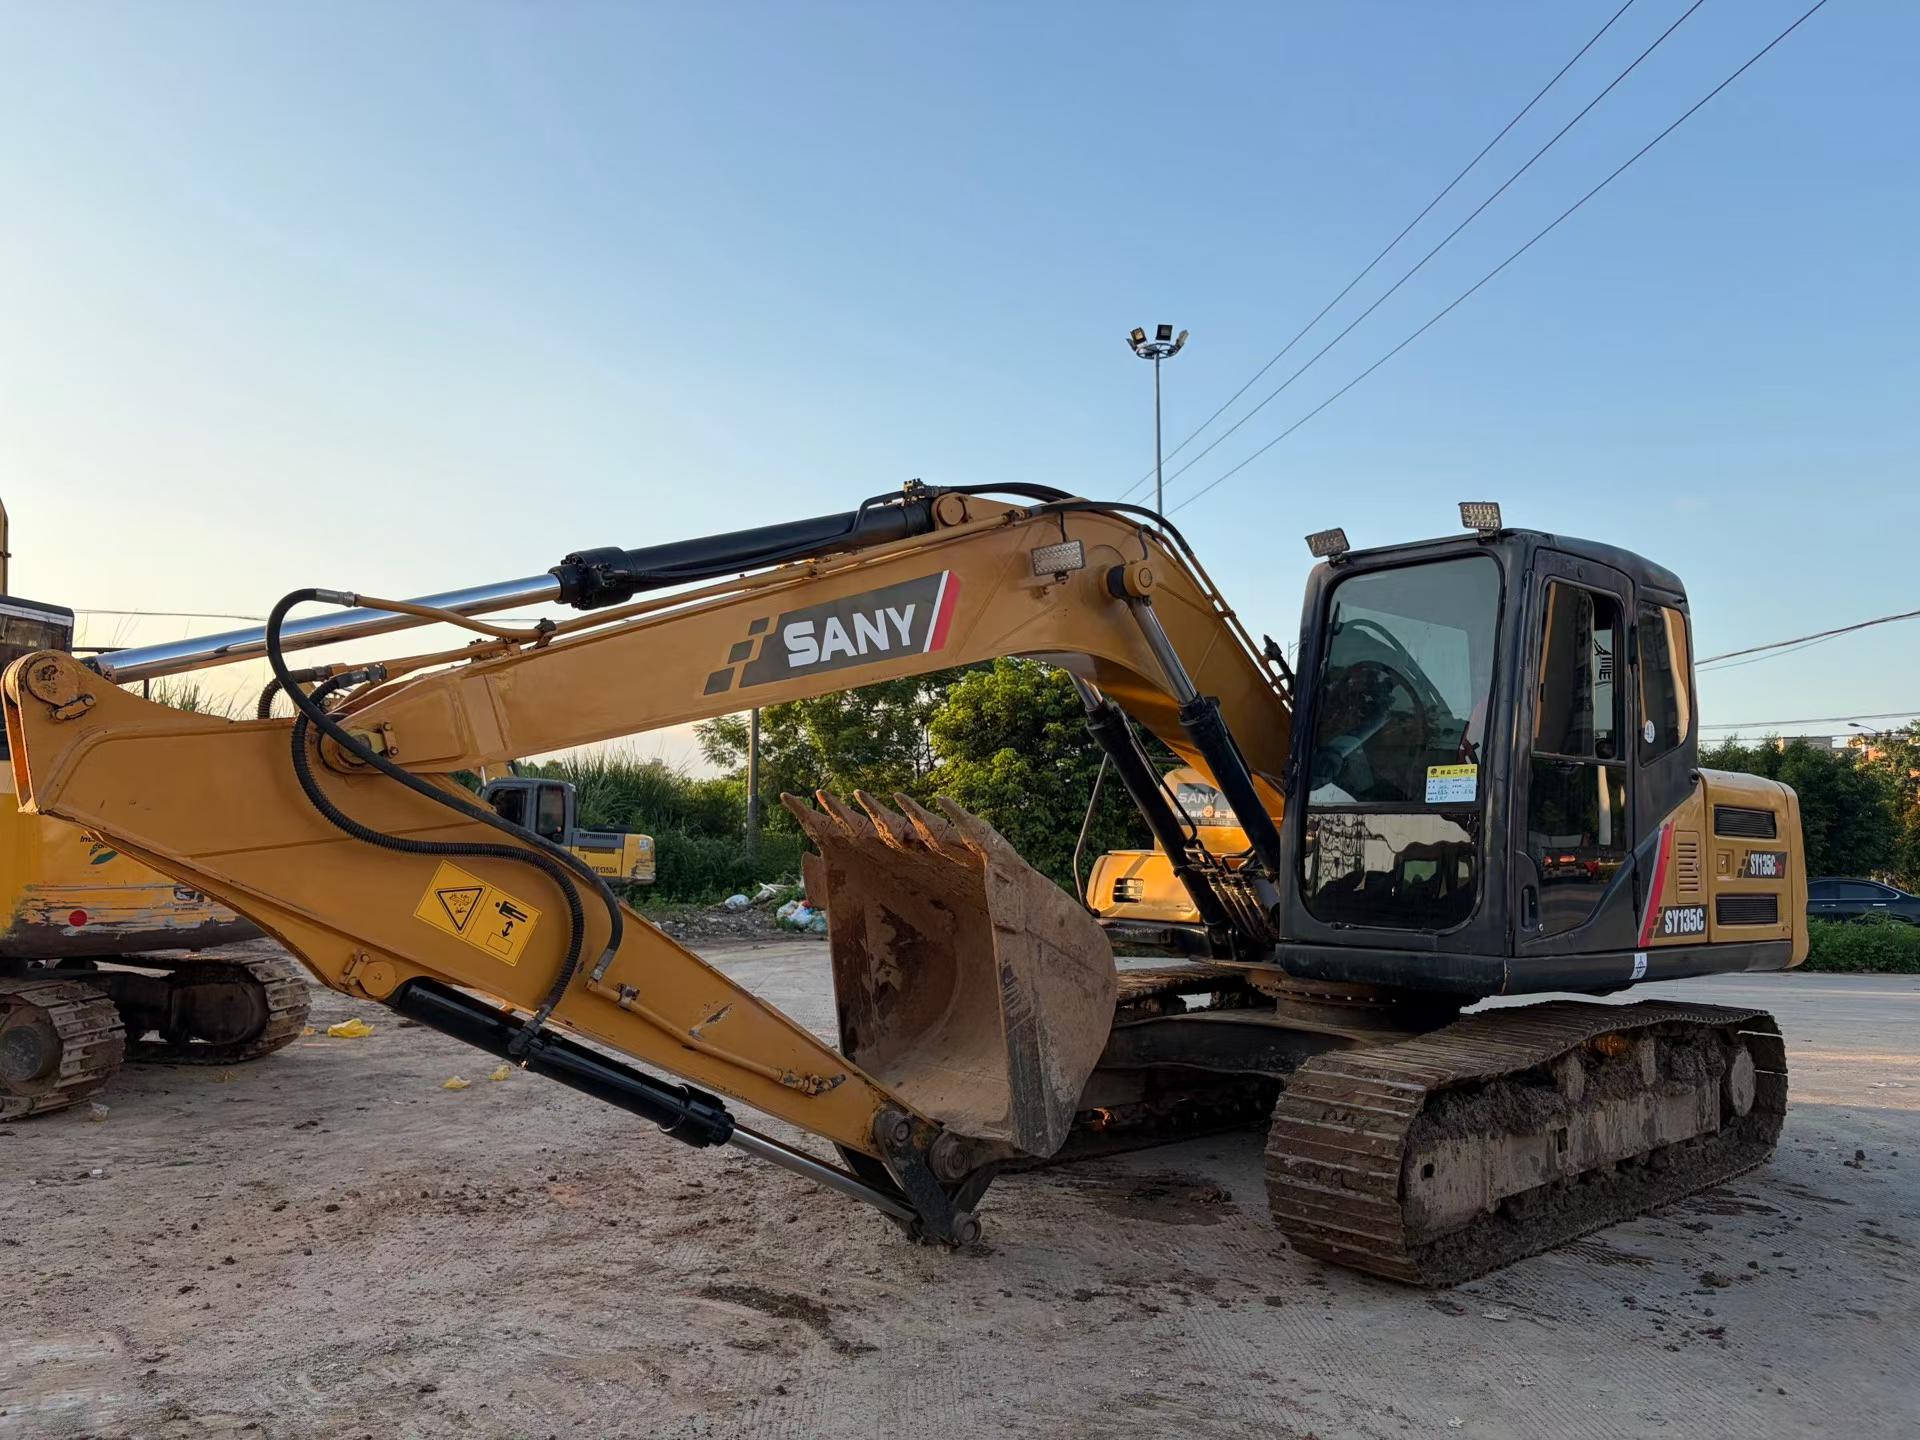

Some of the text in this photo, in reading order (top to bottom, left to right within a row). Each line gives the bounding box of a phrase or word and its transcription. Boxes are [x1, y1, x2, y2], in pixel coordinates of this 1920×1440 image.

[783, 604, 916, 668] SANY
[1178, 792, 1220, 804] SANY
[1750, 853, 1776, 876] SY135C
[1664, 908, 1704, 934] SY135C
